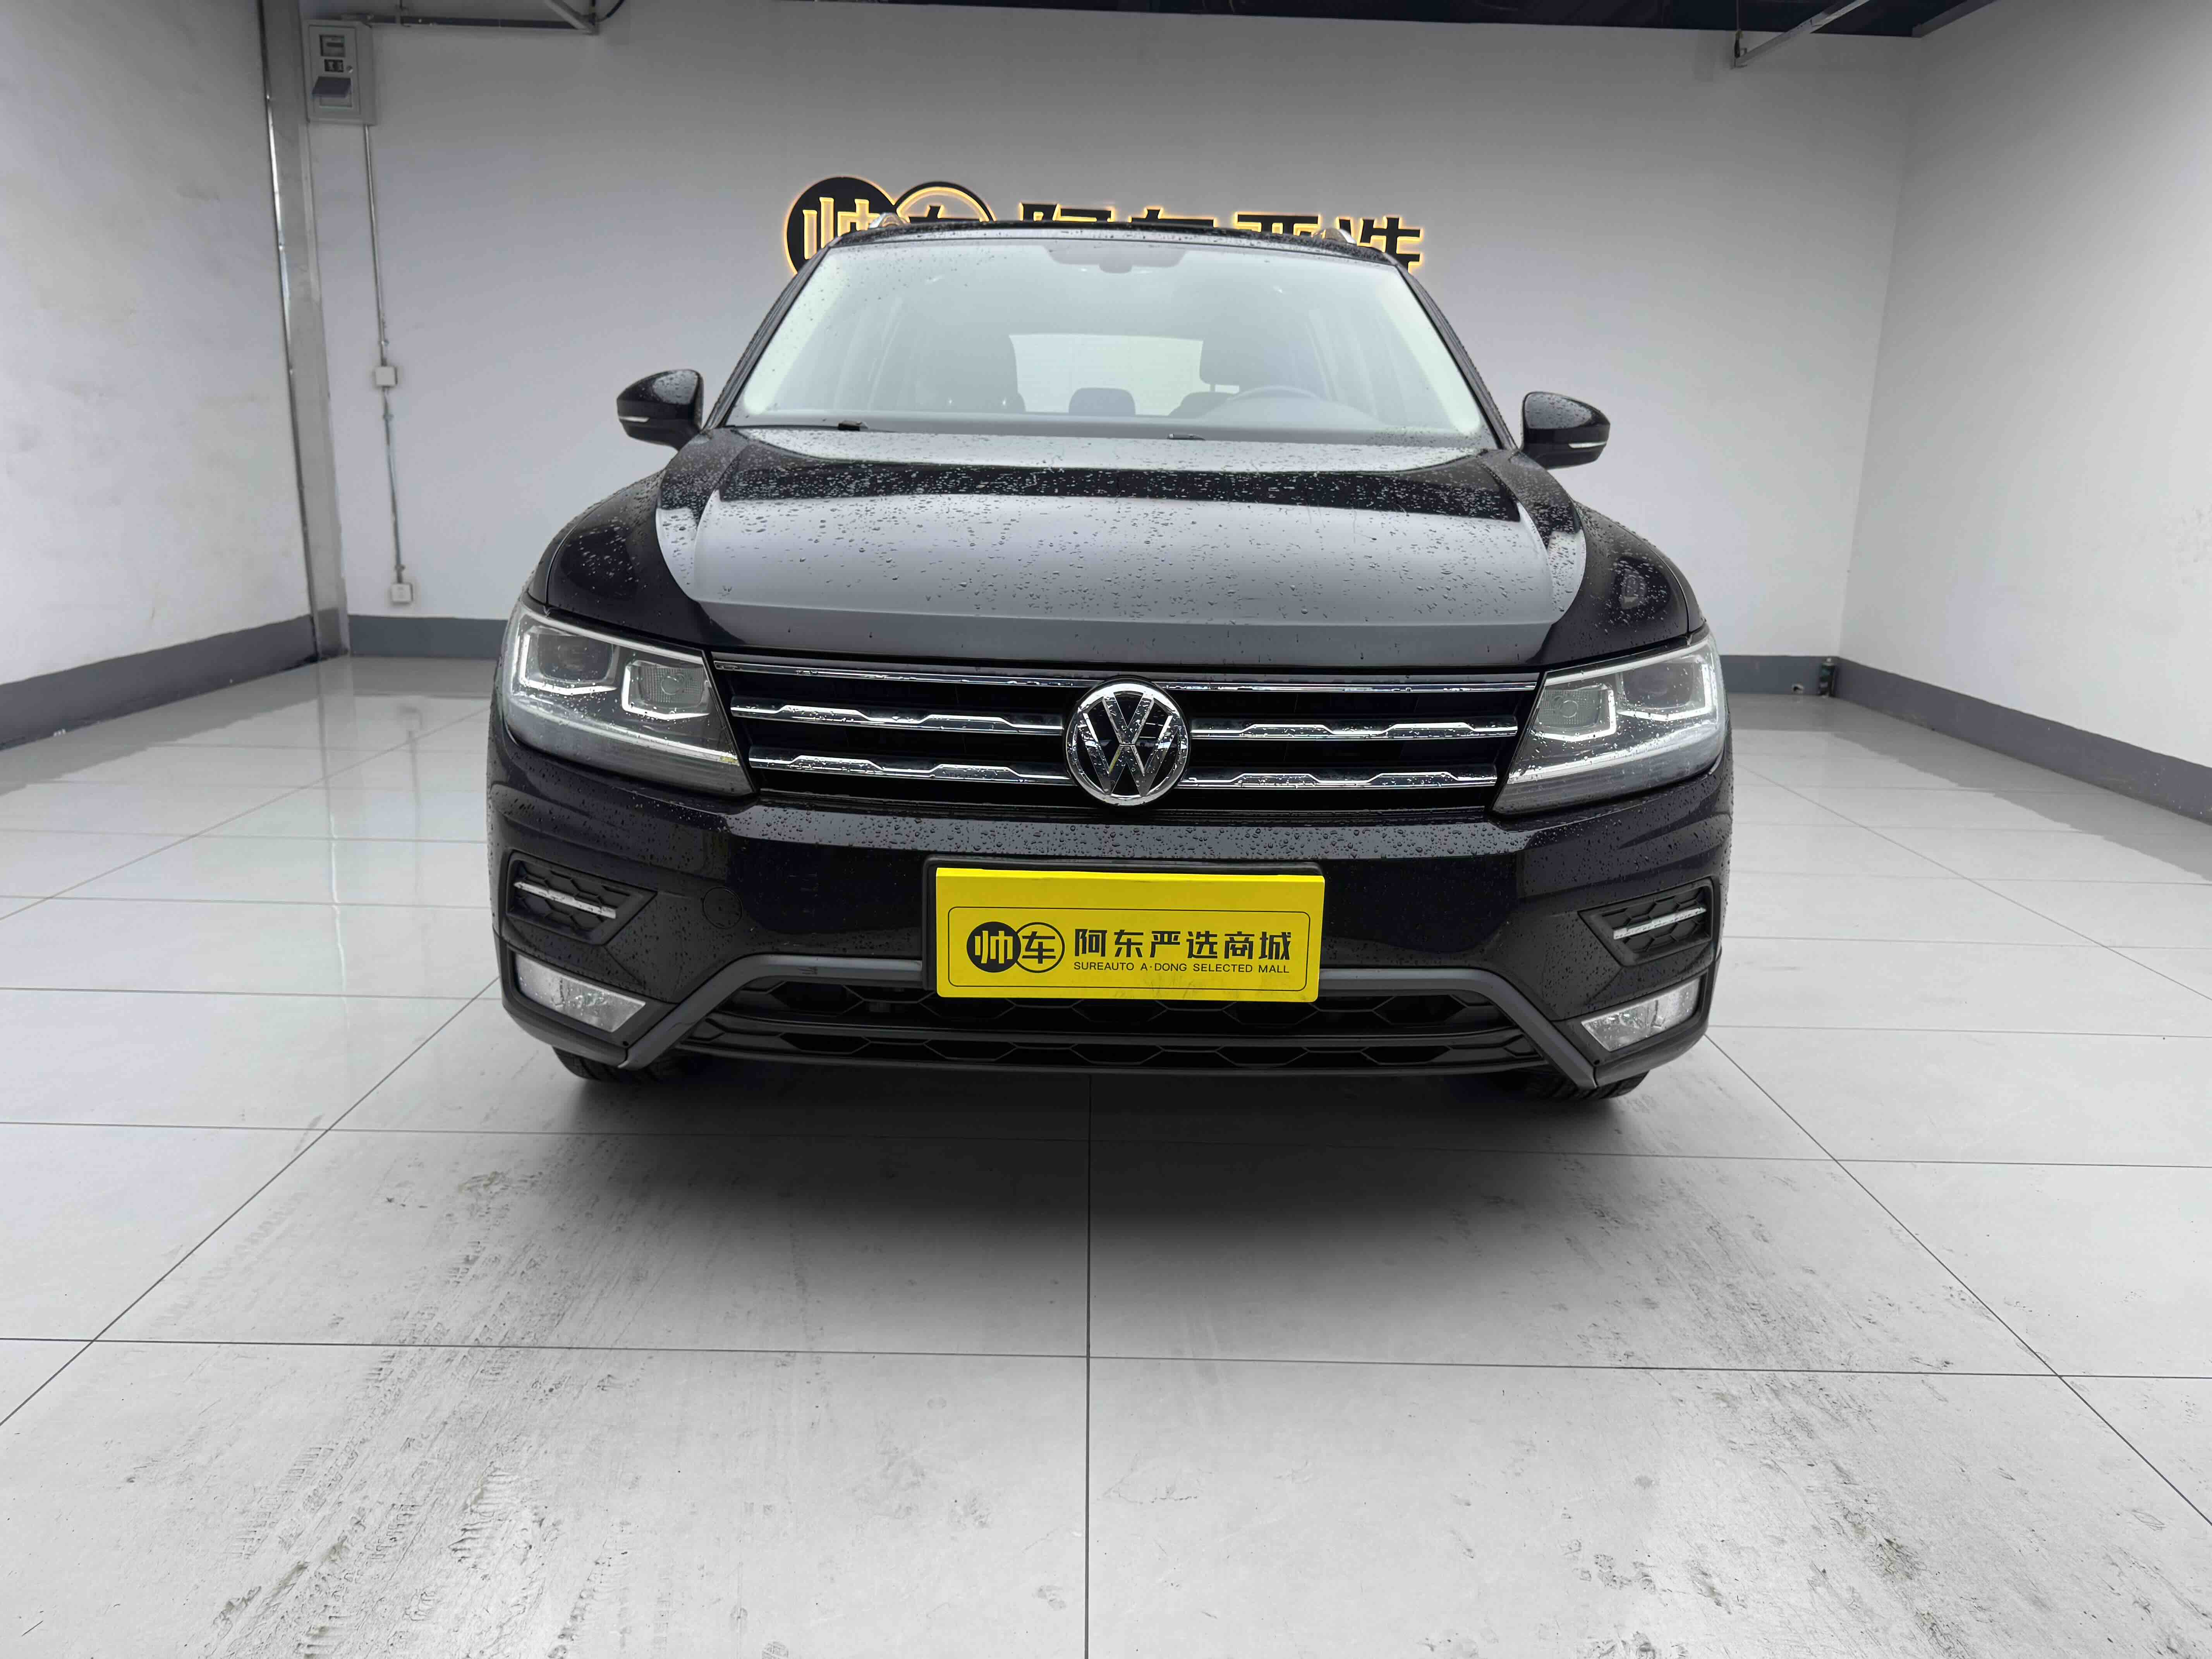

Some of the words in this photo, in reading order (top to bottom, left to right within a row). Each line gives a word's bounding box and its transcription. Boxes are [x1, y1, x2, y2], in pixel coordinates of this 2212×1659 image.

[974, 929, 1056, 965] 帅车
[1074, 928, 1291, 960] 阿东严选商城
[1073, 961, 1135, 971] SUREAUTO
[1192, 963, 1253, 973] SELECTED
[1258, 964, 1290, 974] MALL
